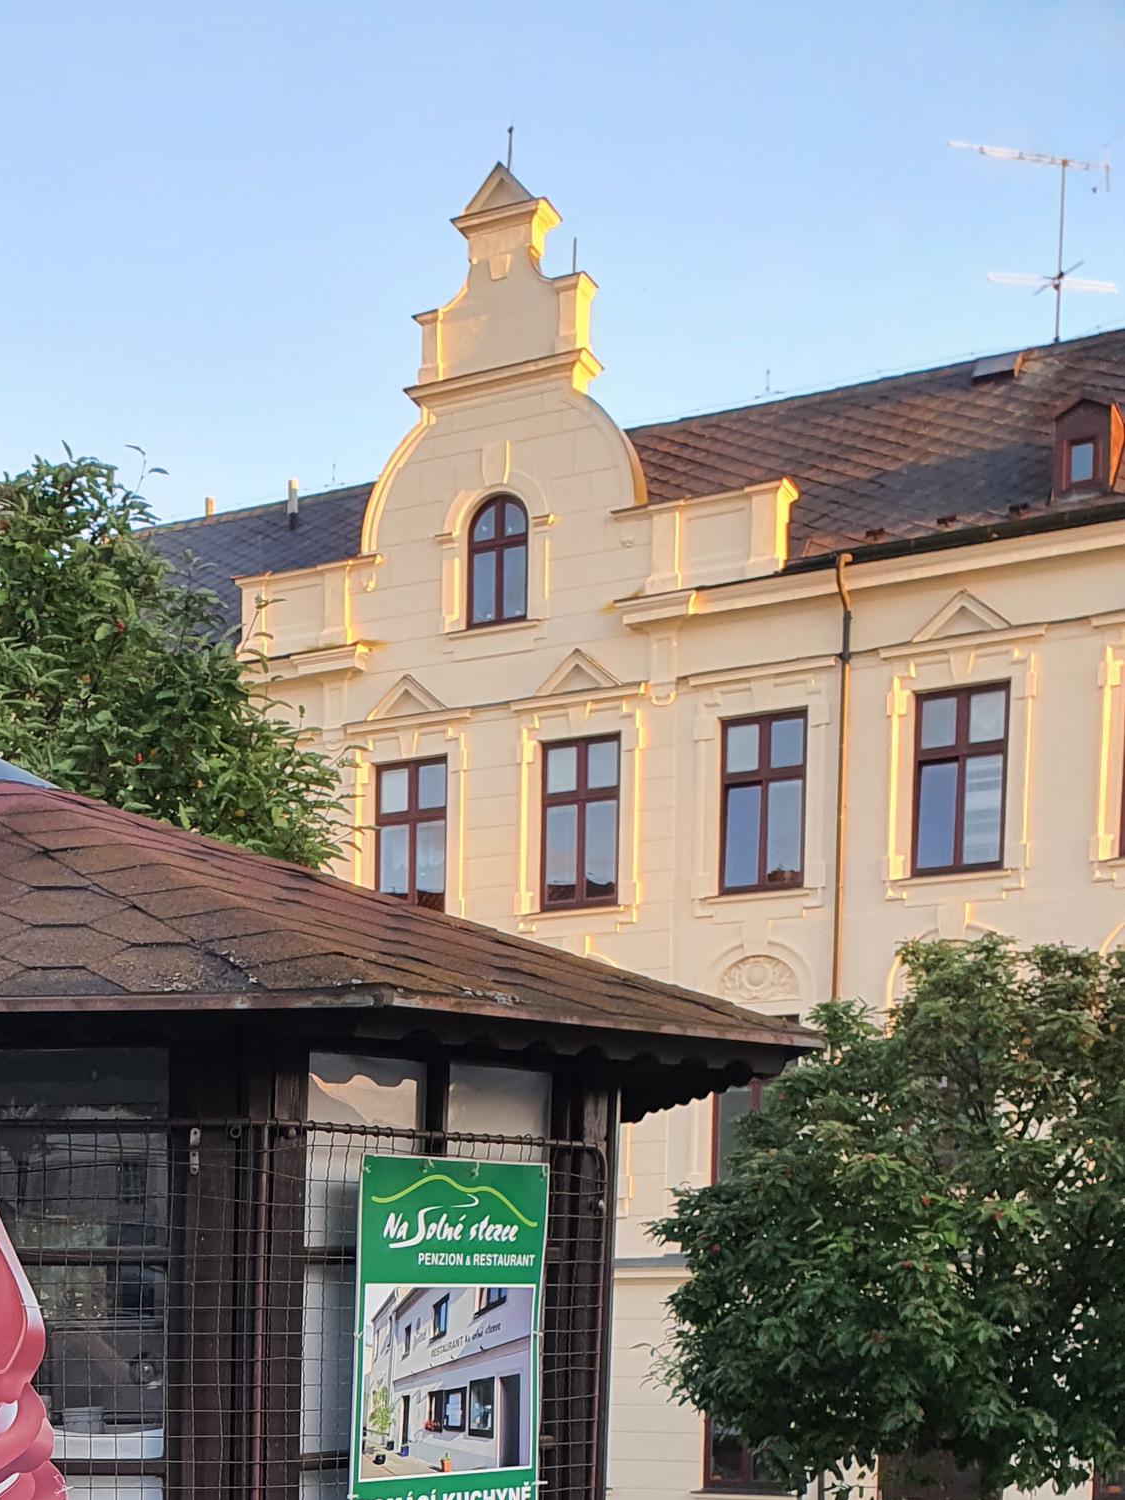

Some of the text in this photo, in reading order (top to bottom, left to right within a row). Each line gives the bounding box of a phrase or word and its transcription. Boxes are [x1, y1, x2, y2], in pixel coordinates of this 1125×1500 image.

[383, 1212, 409, 1240] Na
[389, 1204, 467, 1249] Solné
[418, 1252, 464, 1266] PENZION
[474, 1254, 536, 1267] RESTAURANT
